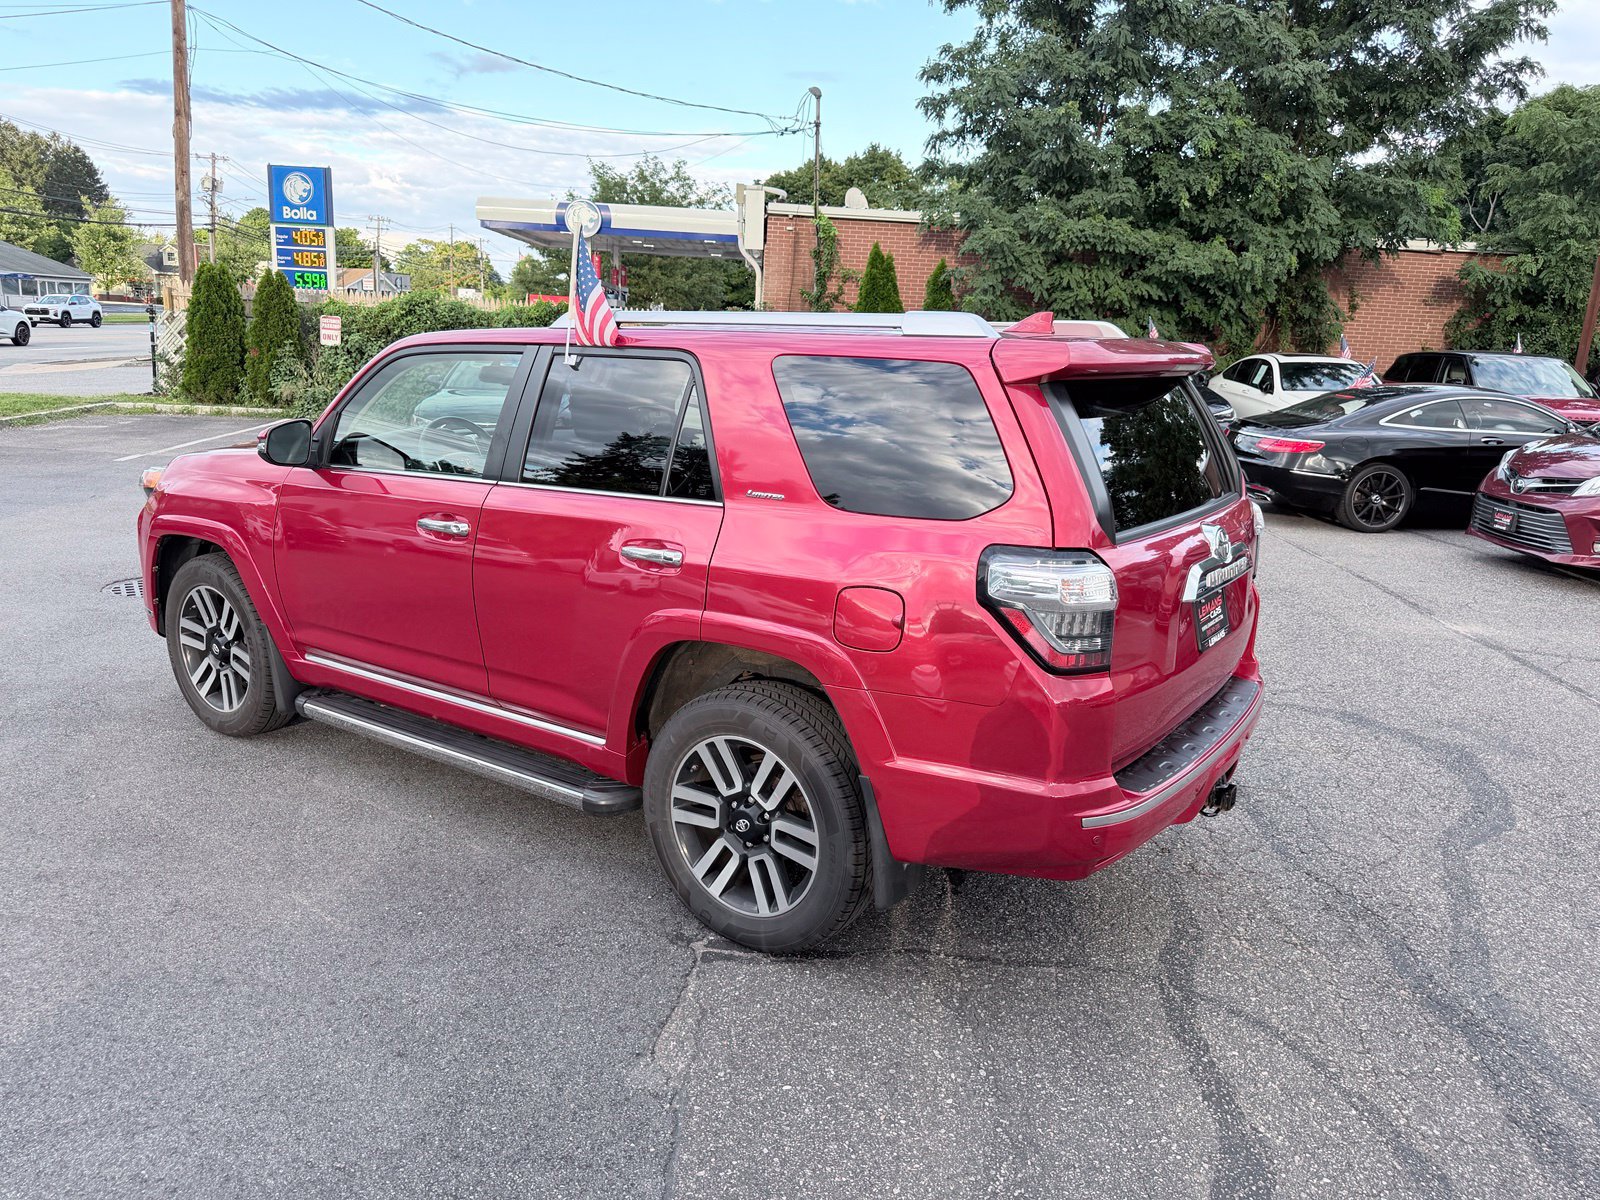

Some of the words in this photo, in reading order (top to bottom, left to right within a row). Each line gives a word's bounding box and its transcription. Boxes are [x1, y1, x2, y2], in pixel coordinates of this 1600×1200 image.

[282, 206, 317, 221] Bolla
[292, 230, 318, 246] 4.05
[293, 251, 319, 267] 4.85
[294, 272, 320, 288] 5.99
[322, 333, 339, 341] ONLY
[1198, 594, 1223, 619] LEMANS
[1210, 605, 1222, 618] CARS
